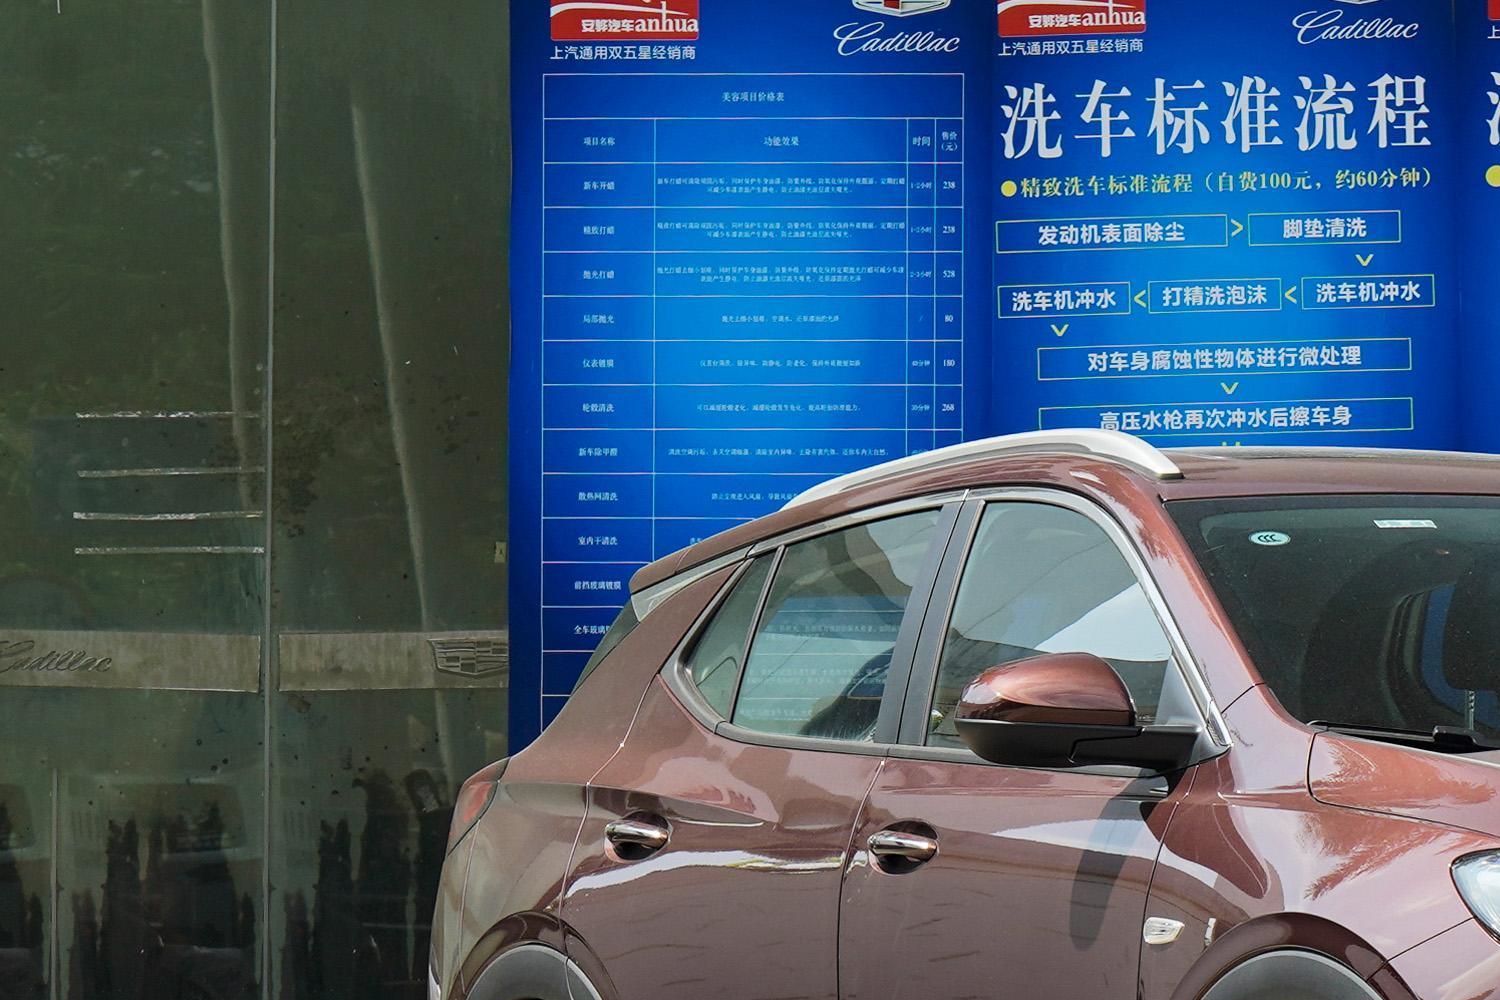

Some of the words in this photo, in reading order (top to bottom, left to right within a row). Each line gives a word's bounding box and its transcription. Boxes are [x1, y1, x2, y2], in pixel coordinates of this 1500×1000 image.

[1292, 9, 1420, 45] Cadillac
[833, 21, 960, 57] Cadillac
[998, 38, 1145, 57] 上汽通用双五星经销商
[550, 45, 697, 61] 上汽通用双五星经销商
[722, 91, 785, 102] 美容项目价格表
[1000, 73, 1432, 160] 洗车标准流程
[763, 136, 799, 147] 功能效果
[912, 136, 931, 147] 时间
[941, 131, 958, 141] 售价
[1038, 221, 1186, 246] 发动机表面除尘
[1282, 217, 1367, 239] 脚垫清洗
[942, 269, 956, 279] 528
[1012, 288, 1117, 312] 洗车机冲水
[1162, 285, 1268, 306] 打精洗泡沫
[1316, 281, 1421, 303] 洗车机冲水
[944, 314, 954, 323] 80
[943, 358, 956, 368] 180
[1087, 346, 1362, 373] 对车身腐蚀性物体进行微处理
[1100, 404, 1352, 432] 高压水枪再次冲水后擦车身
